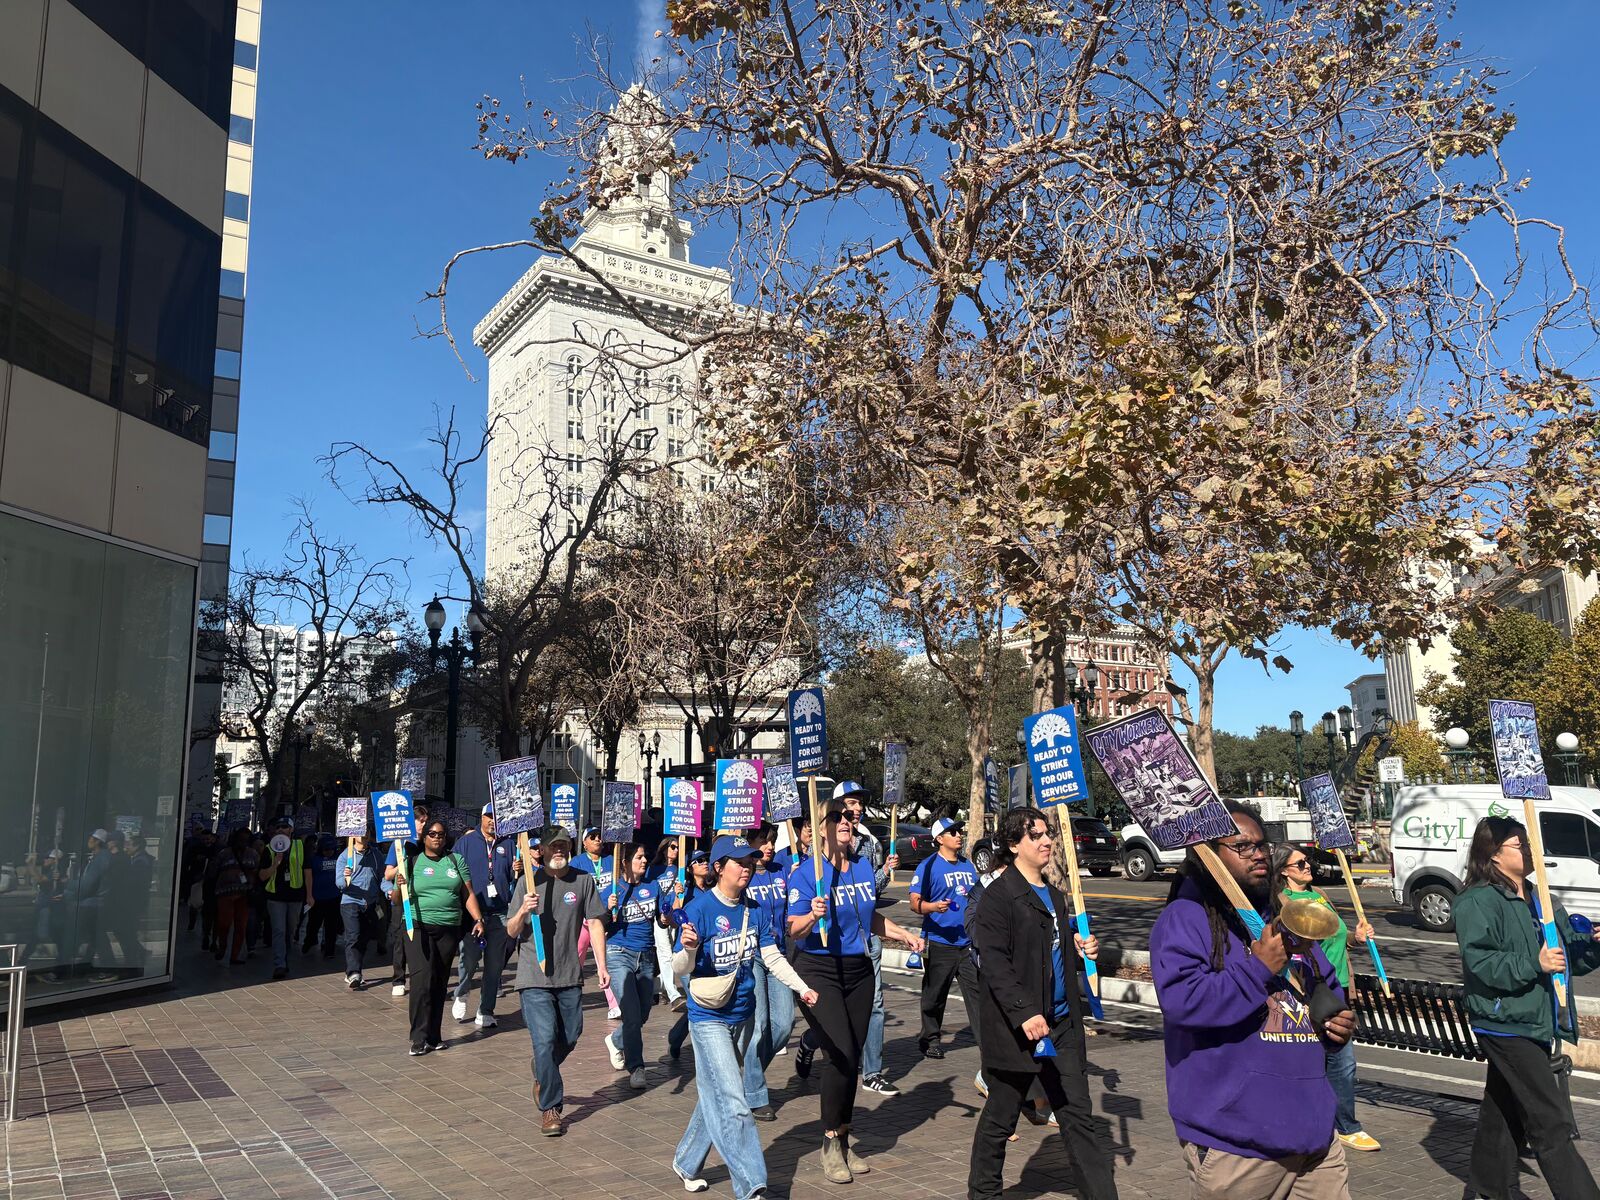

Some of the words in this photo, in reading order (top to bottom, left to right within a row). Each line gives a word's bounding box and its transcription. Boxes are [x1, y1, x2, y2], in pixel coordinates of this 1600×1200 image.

[795, 724, 813, 734] READY
[800, 735, 819, 745] STRIKE
[1092, 728, 1120, 760] CITY
[1119, 716, 1165, 746] WORKERS
[799, 748, 810, 757] FOR
[811, 746, 821, 754] OUR
[1034, 748, 1058, 762] READY
[1060, 745, 1072, 755] TO
[798, 756, 823, 768] SERVICES
[1041, 759, 1068, 772] STRIKE
[1041, 775, 1056, 785] FOR
[1057, 770, 1074, 780] OUR
[1041, 782, 1078, 798] SERVICES
[1151, 822, 1182, 845] MAKE
[1177, 802, 1225, 834] OAKLAND
[1403, 816, 1474, 846] CityL
[944, 871, 975, 887] IFPTE
[746, 884, 786, 900] IFPTE
[831, 882, 876, 906] IFPTE
[1260, 1032, 1293, 1042] UNITE
[1294, 1034, 1306, 1042] TO
[1308, 1034, 1320, 1042] FIG
